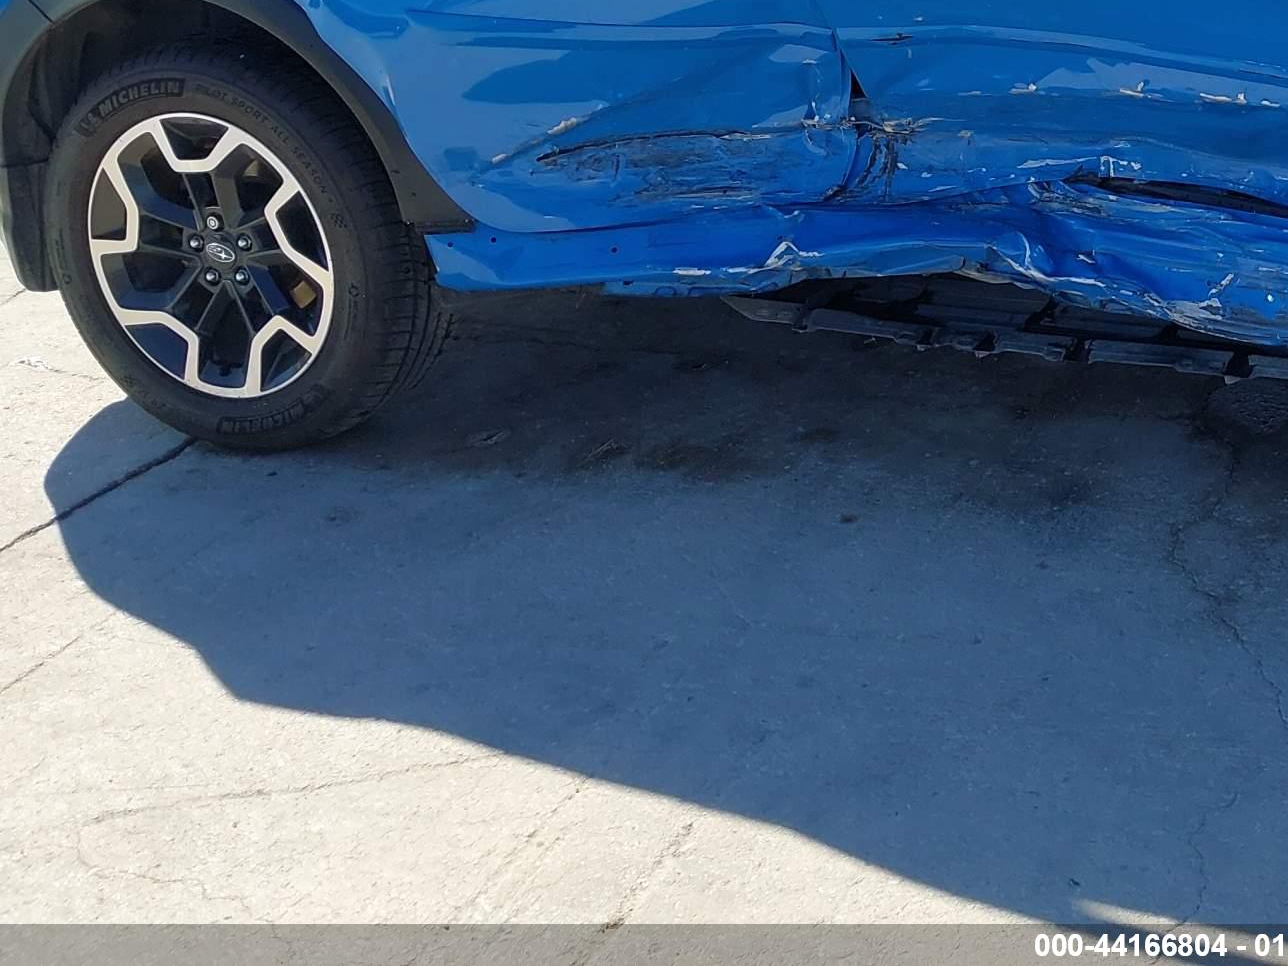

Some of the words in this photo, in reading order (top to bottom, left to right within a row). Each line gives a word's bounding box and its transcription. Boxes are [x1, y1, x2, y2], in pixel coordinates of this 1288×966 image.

[98, 81, 180, 117] MICHELIN
[231, 96, 270, 123] SPORT
[269, 125, 290, 145] ALL
[291, 146, 328, 194] SEASON
